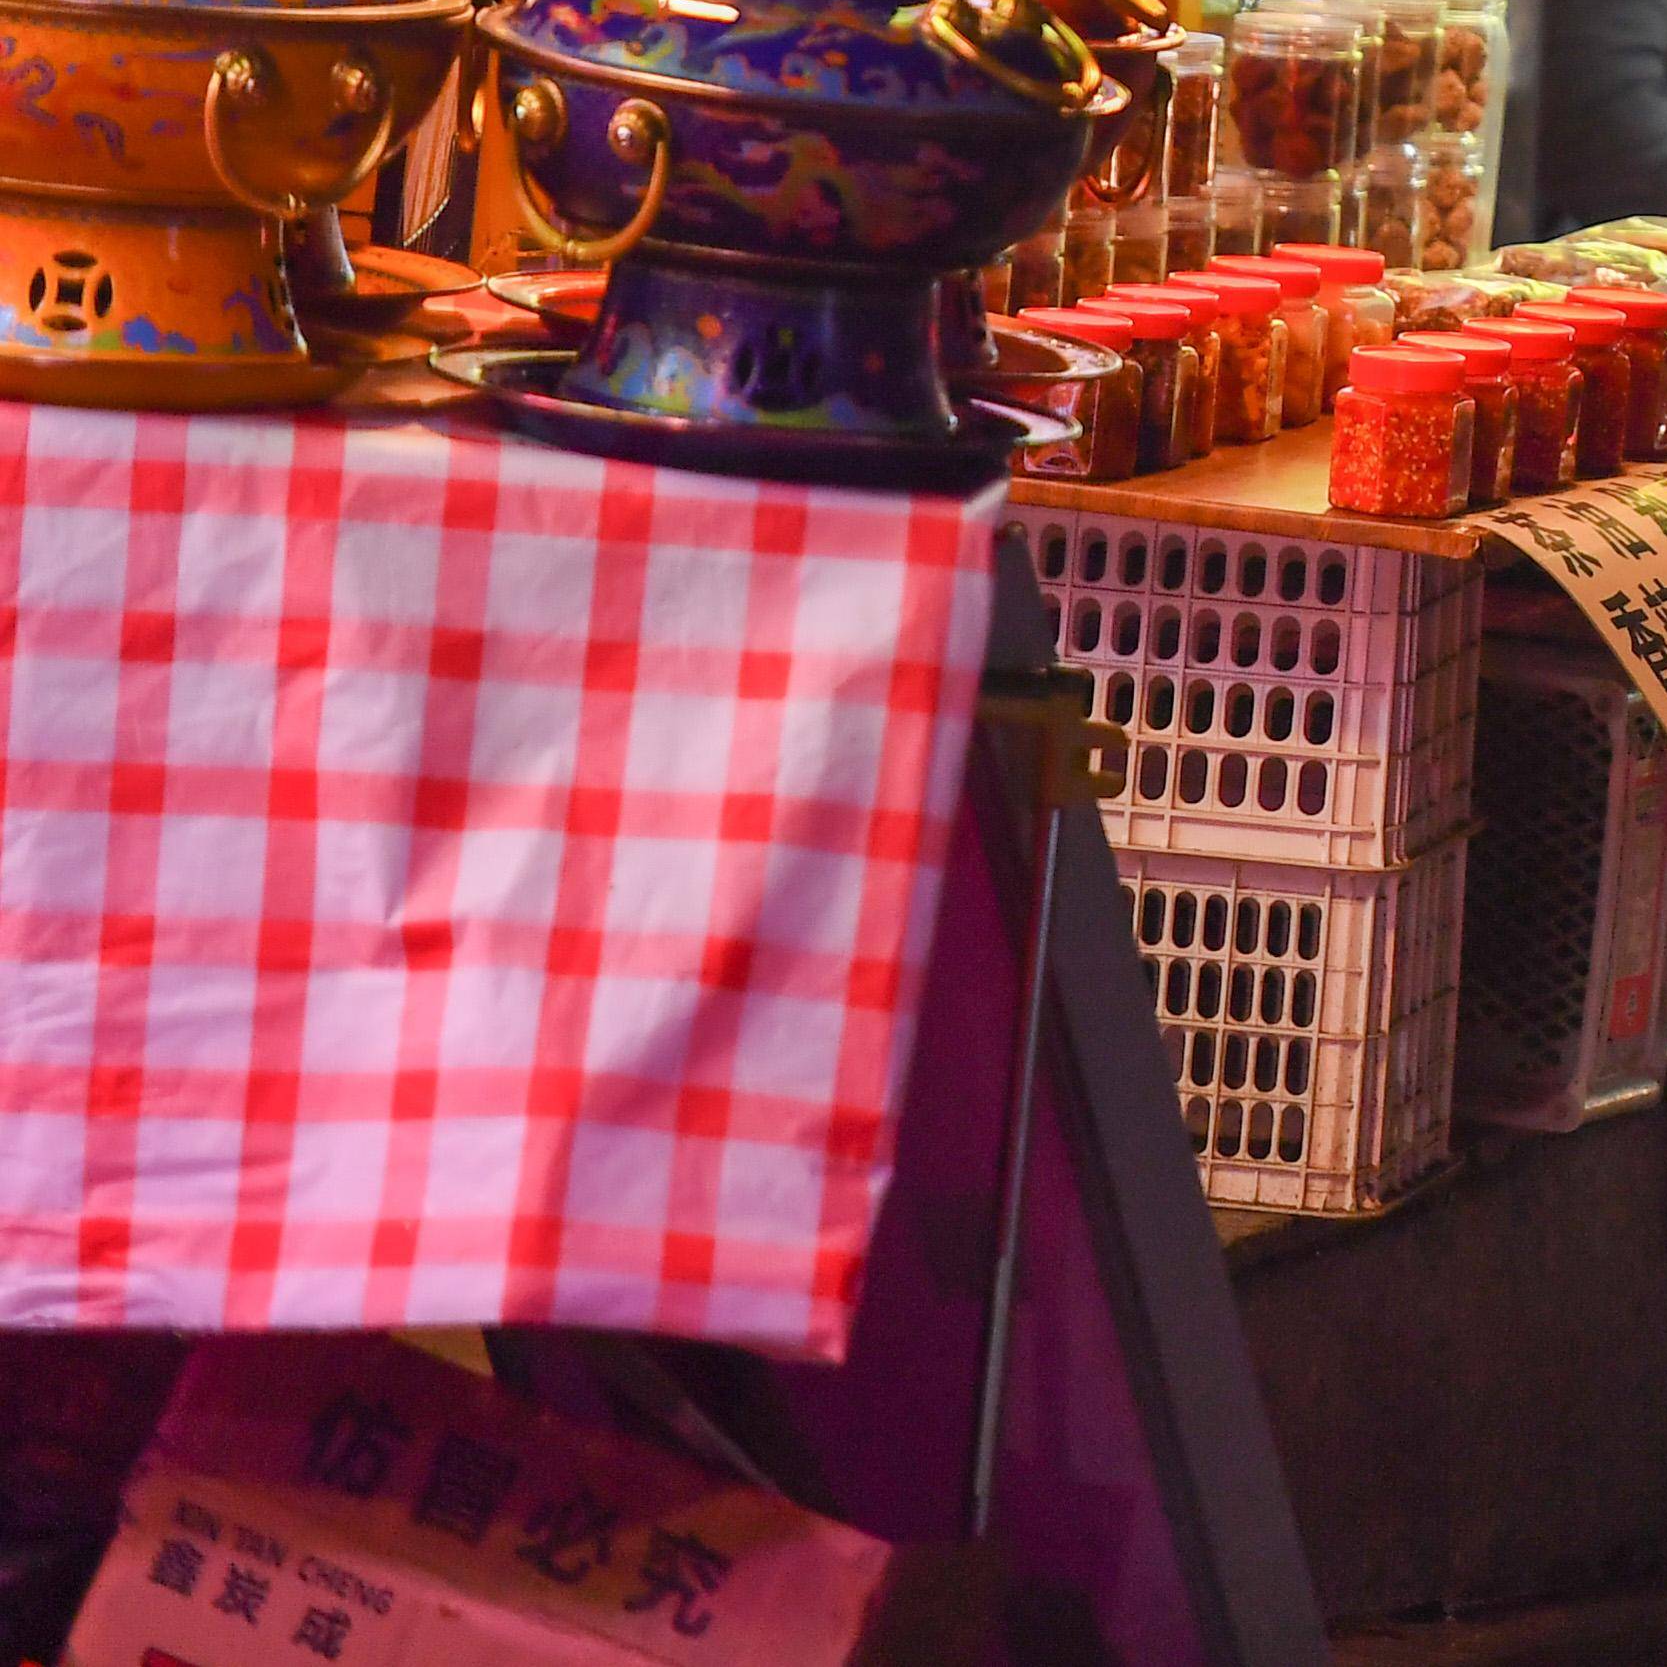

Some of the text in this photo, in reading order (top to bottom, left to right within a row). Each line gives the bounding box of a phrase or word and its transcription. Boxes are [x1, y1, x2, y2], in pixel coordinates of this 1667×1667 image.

[297, 1555, 395, 1616] CHENG
[304, 1392, 732, 1640] 仿冒必究
